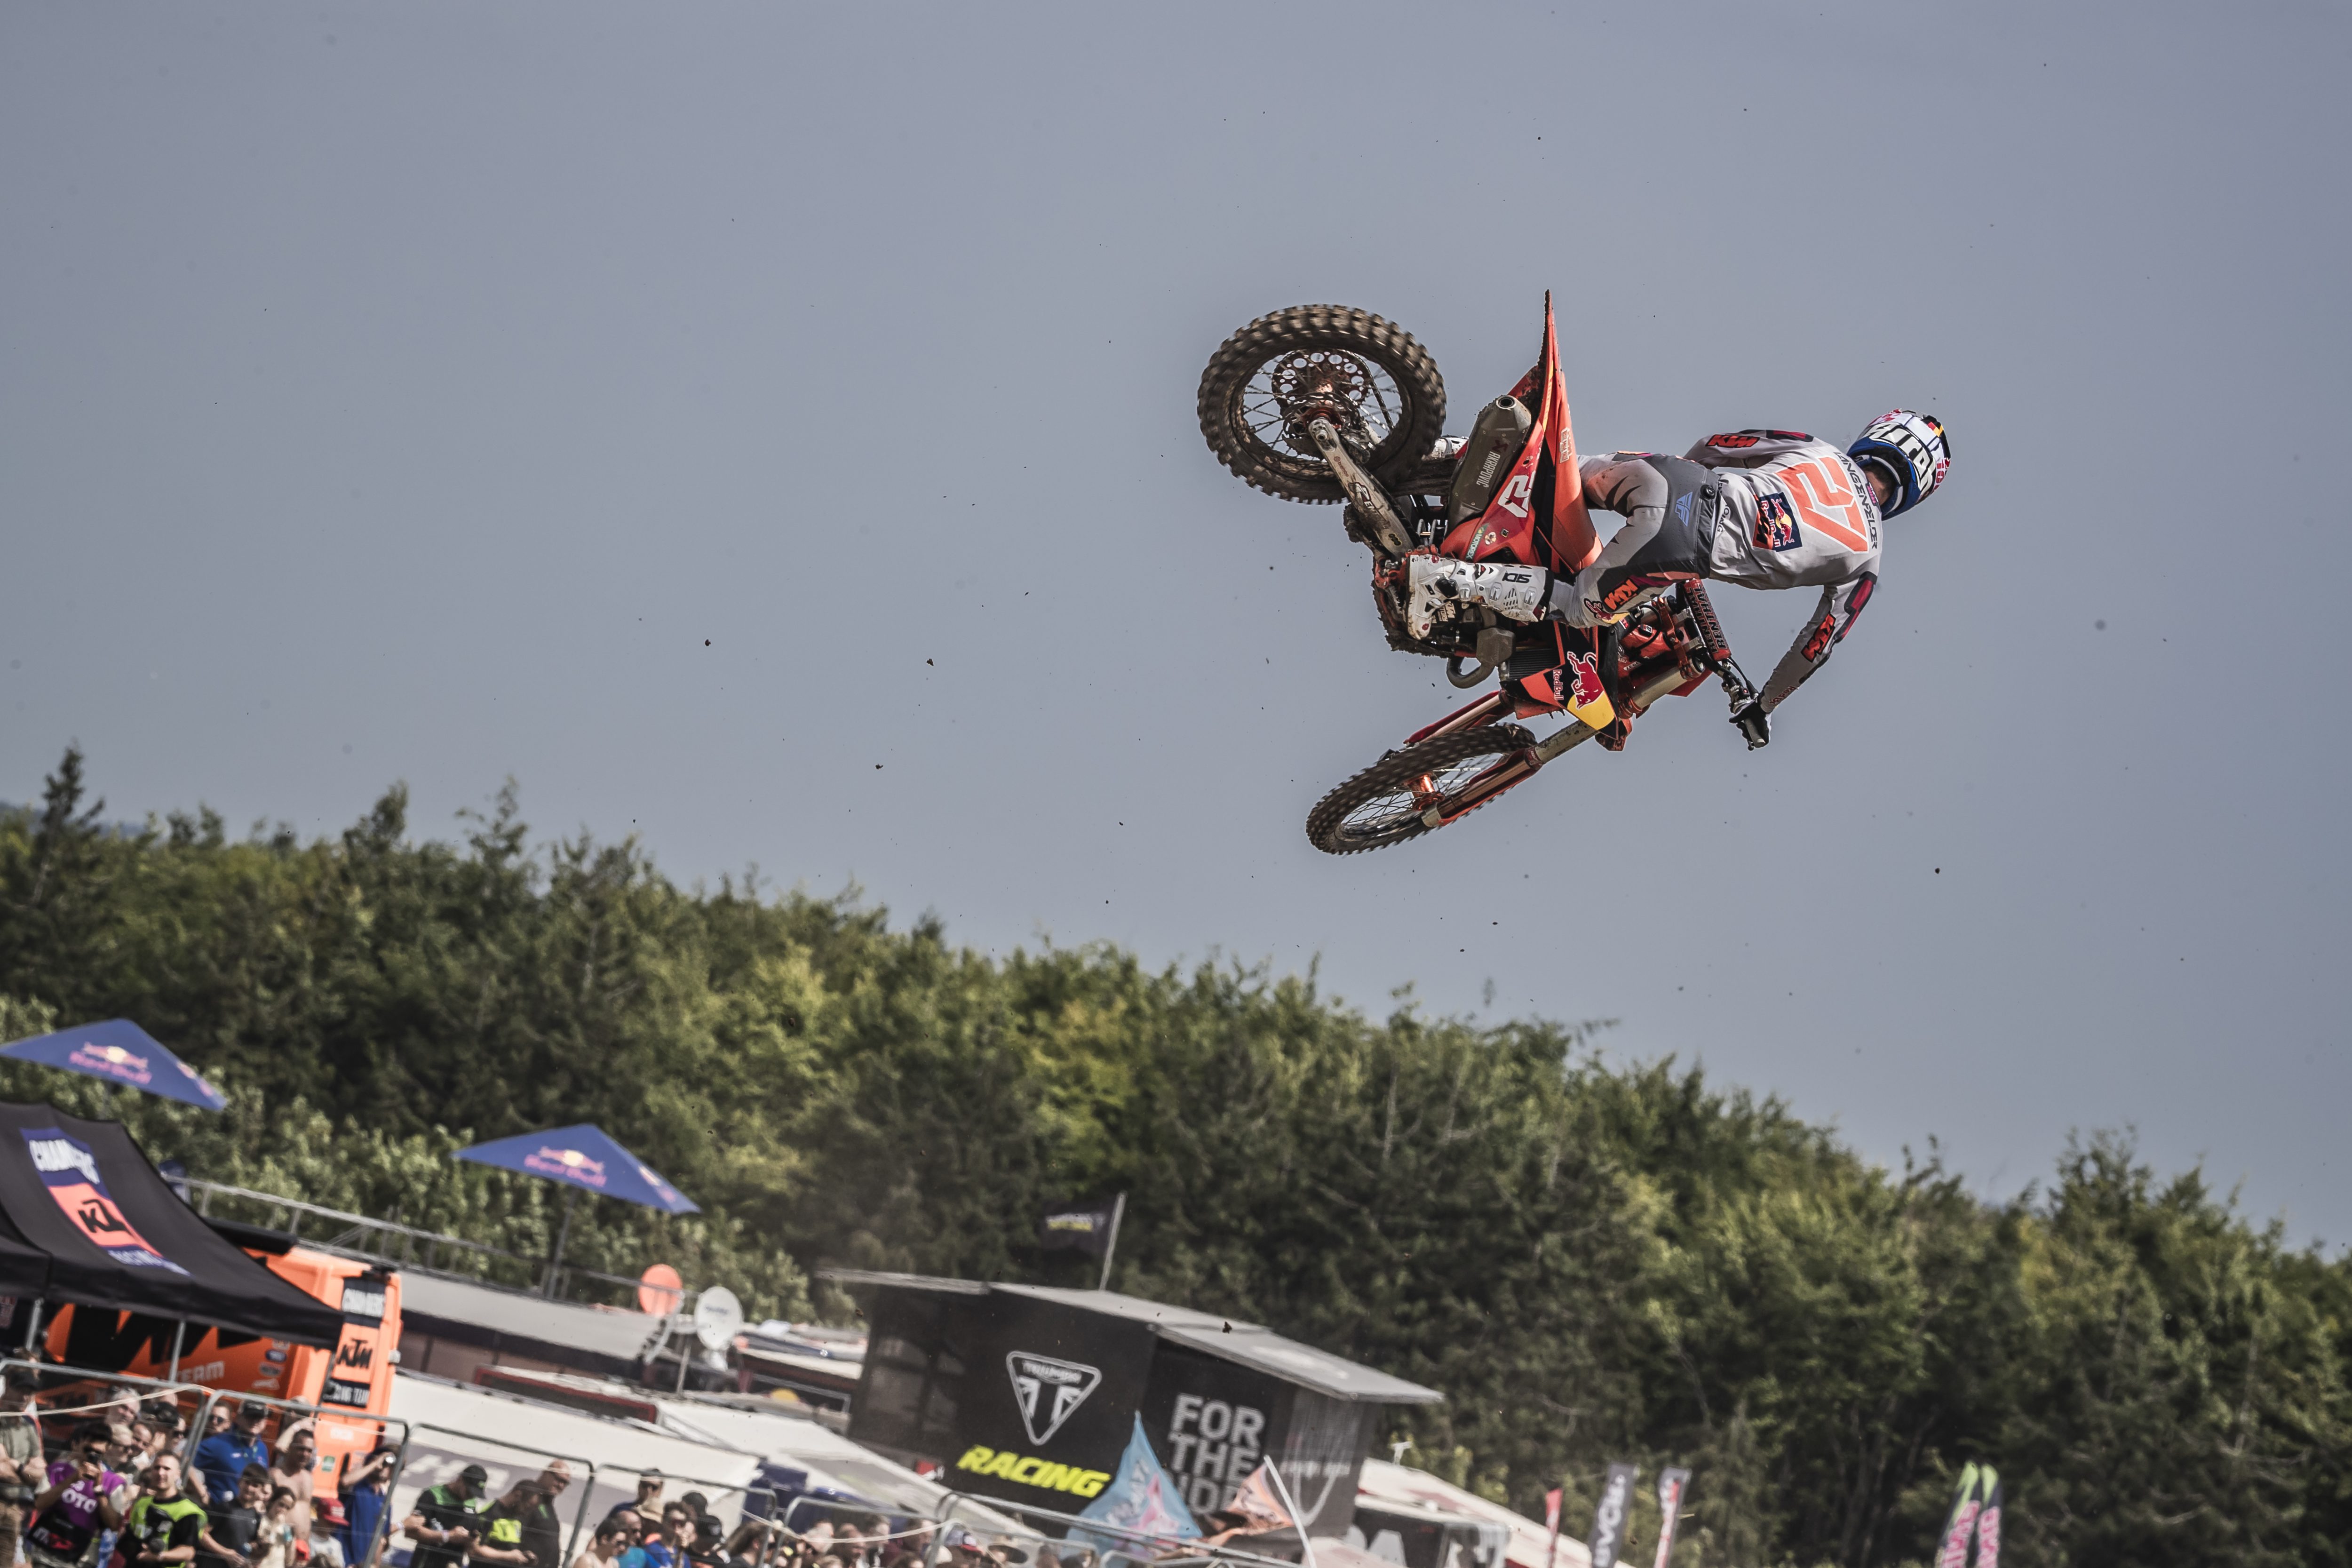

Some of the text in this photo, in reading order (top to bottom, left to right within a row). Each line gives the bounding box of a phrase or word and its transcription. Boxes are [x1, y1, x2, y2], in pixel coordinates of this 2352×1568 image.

[1705, 434, 1760, 448] KTM
[1497, 470, 1535, 517] 27
[1775, 455, 1869, 554] 27
[1466, 532, 1482, 560] MOTOREX
[1604, 579, 1639, 610] KTM
[1694, 587, 1727, 650] RENTHAL
[1801, 613, 1836, 662] KTM
[1553, 669, 1564, 701] Red Bull
[337, 1338, 373, 1369] KTM
[1170, 1393, 1265, 1449] FOR
[957, 1443, 1112, 1498] RACING
[1168, 1430, 1262, 1488] THE
